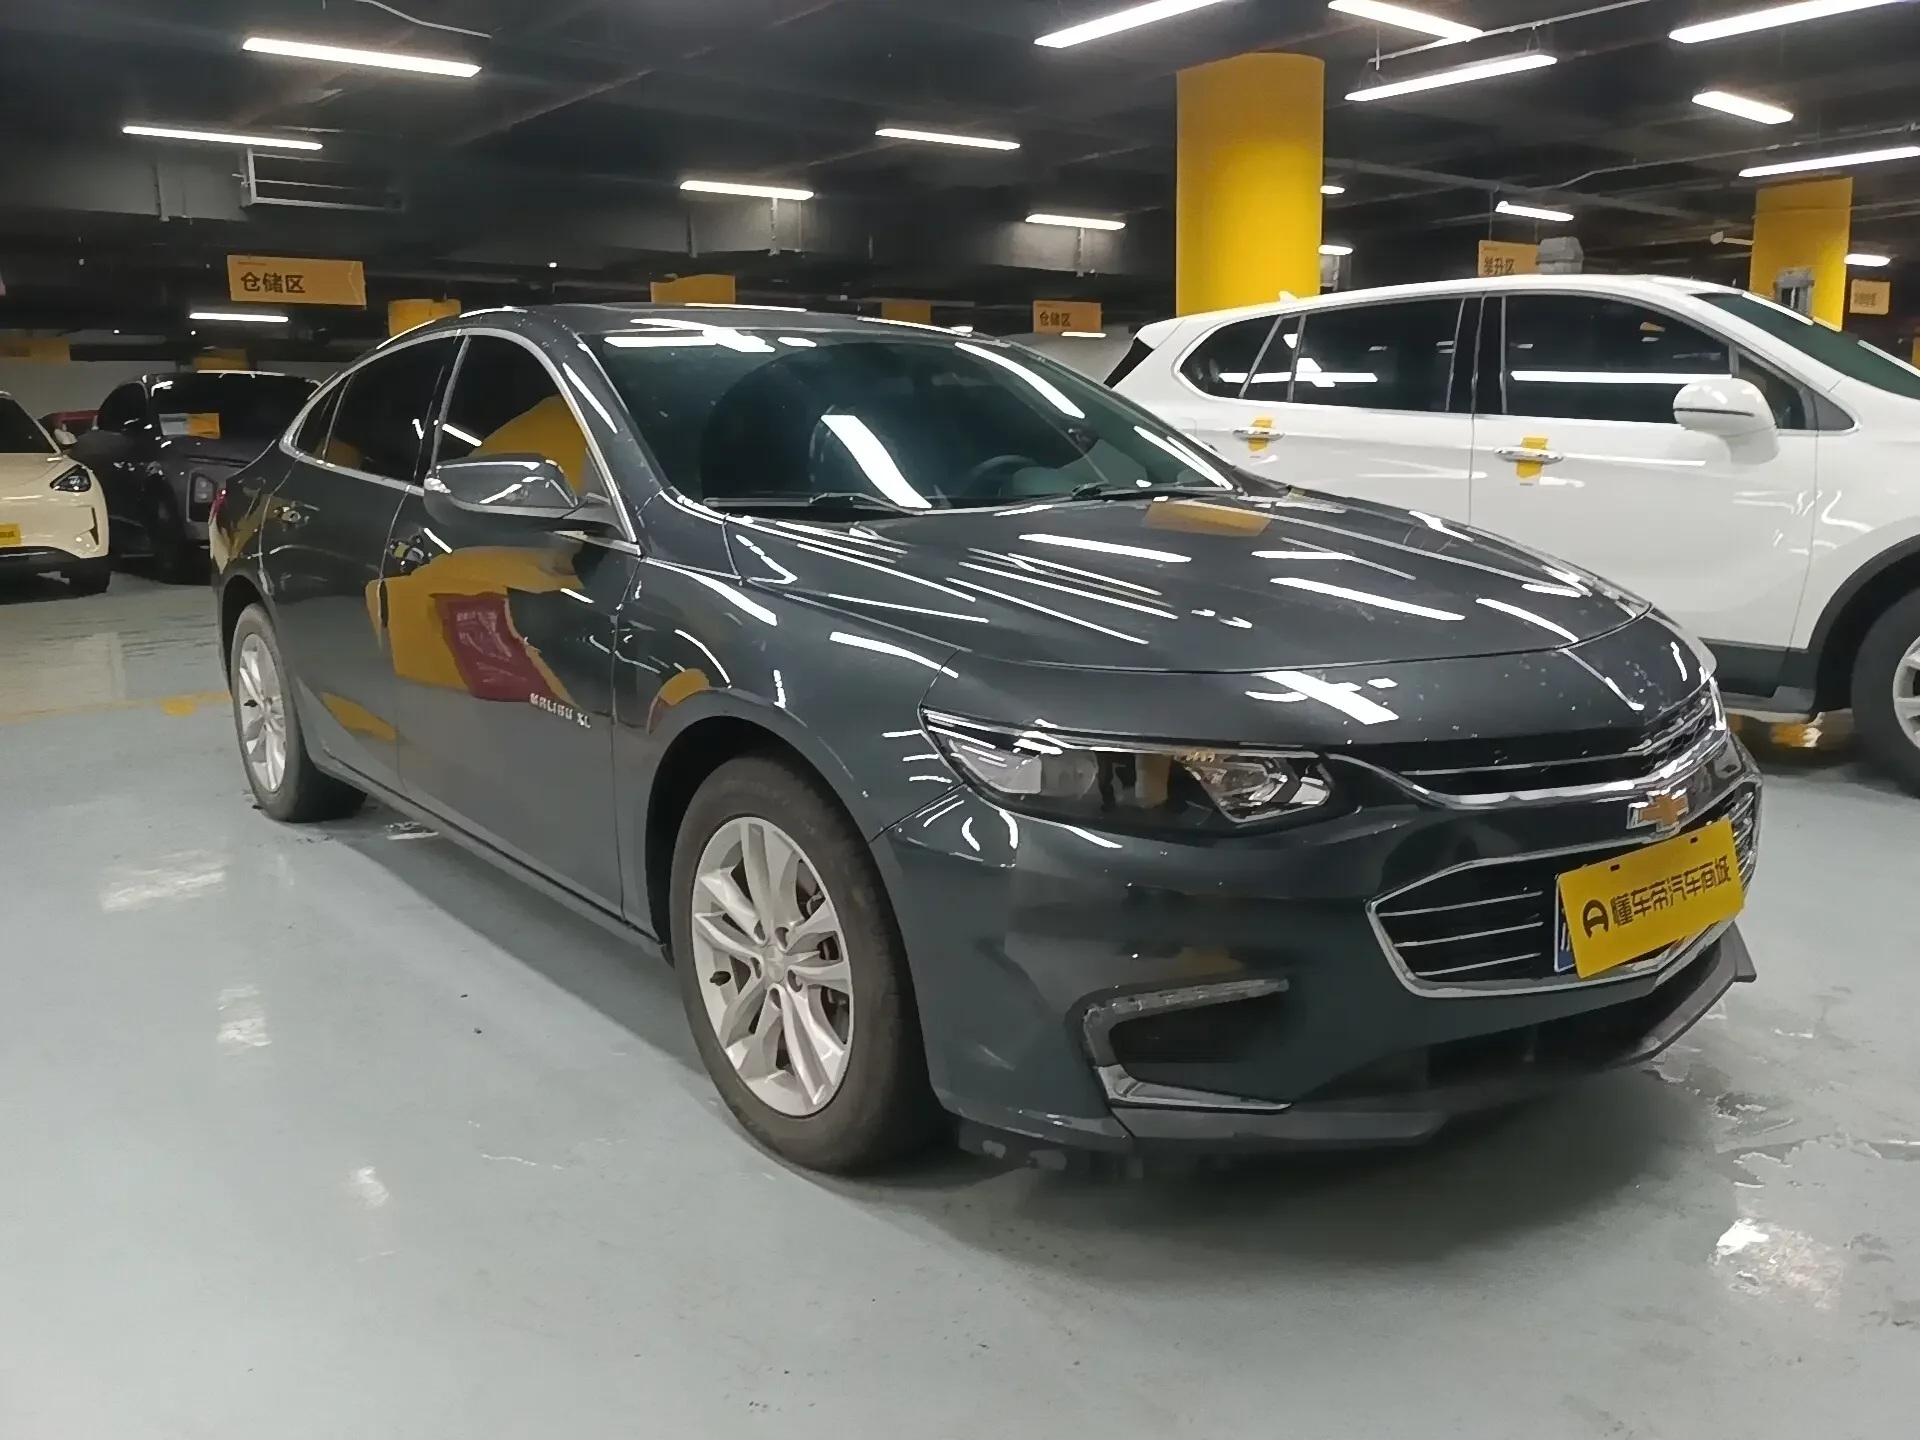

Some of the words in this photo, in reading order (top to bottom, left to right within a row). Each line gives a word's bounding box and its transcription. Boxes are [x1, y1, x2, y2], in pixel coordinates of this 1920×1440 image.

[240, 271, 306, 294] 仓储区
[530, 692, 573, 720] MALIBU
[577, 712, 591, 728] XL
[1609, 854, 1732, 927] 懂车帝汽车商城
